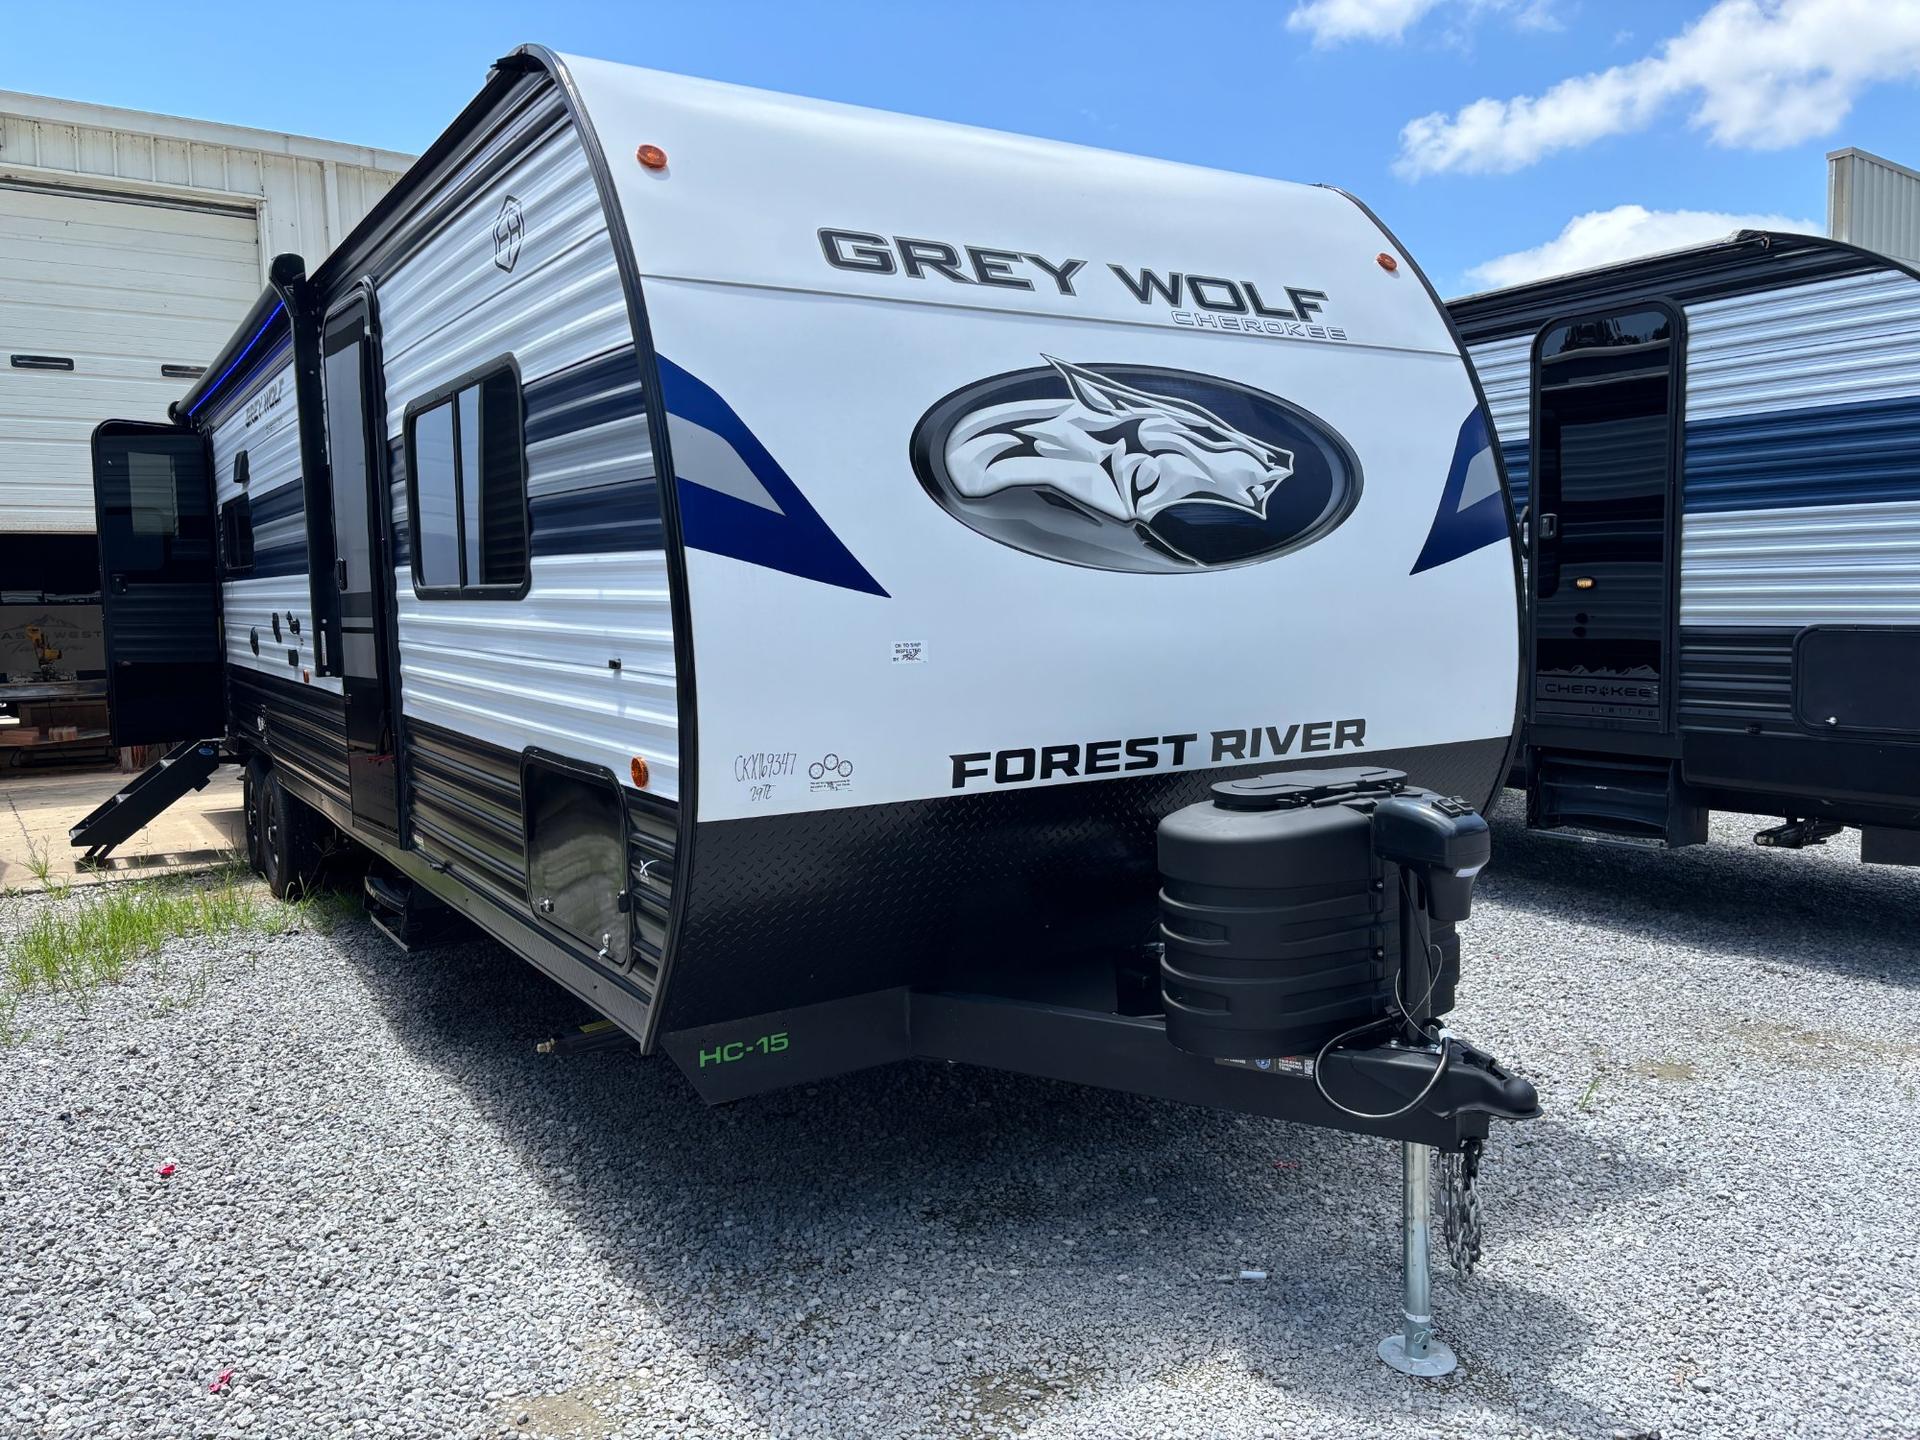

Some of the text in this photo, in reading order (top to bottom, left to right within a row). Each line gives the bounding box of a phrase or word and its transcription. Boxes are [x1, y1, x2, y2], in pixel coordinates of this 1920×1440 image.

[817, 227, 1329, 323] GREY WOLF
[1171, 310, 1347, 341] CHEROKEE
[949, 718, 1367, 789] FOREST RIVER
[699, 1032, 790, 1068] HC-15
